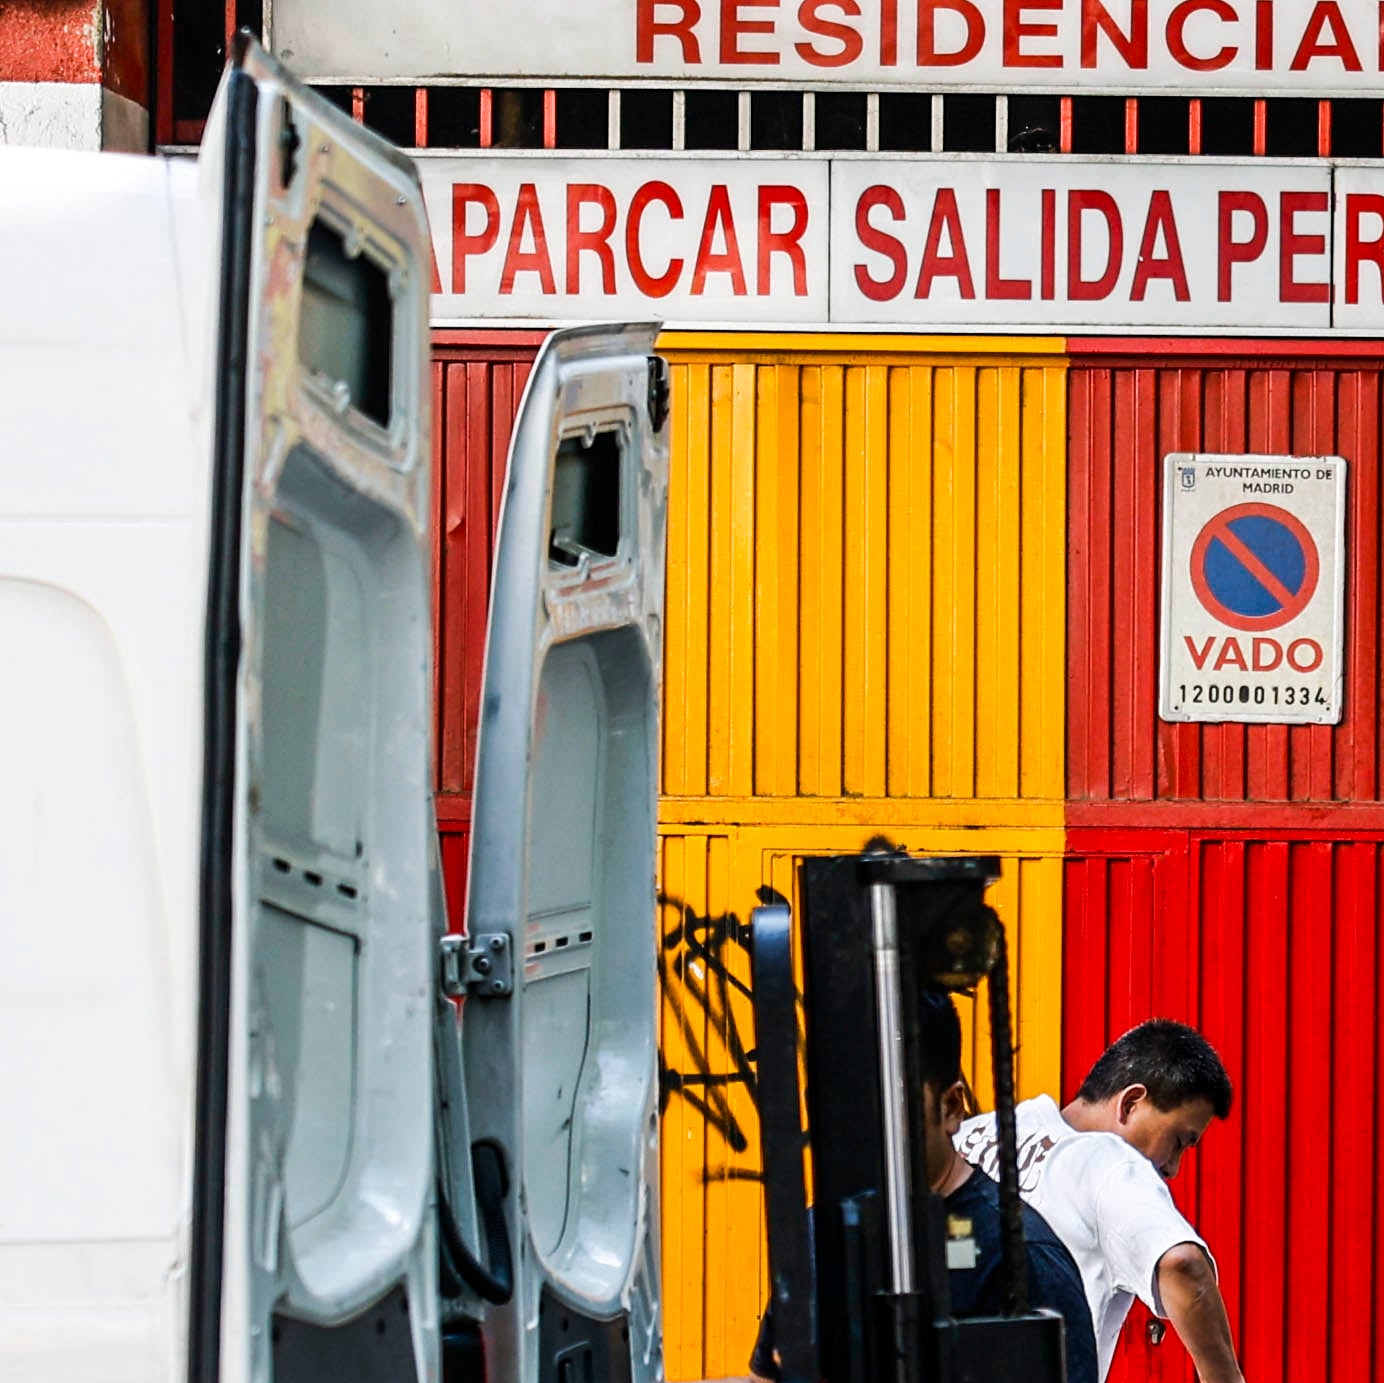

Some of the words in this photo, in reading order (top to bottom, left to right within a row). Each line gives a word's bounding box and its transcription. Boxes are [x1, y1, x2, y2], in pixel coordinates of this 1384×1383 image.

[431, 181, 809, 298] PARCAR
[853, 184, 1191, 303] SALIDA
[1205, 468, 1311, 480] AYUNTAMIENTO
[1316, 469, 1333, 481] DE
[1242, 483, 1294, 495] MADRID
[1183, 635, 1325, 673] VADO
[1180, 684, 1326, 705] 120001334
